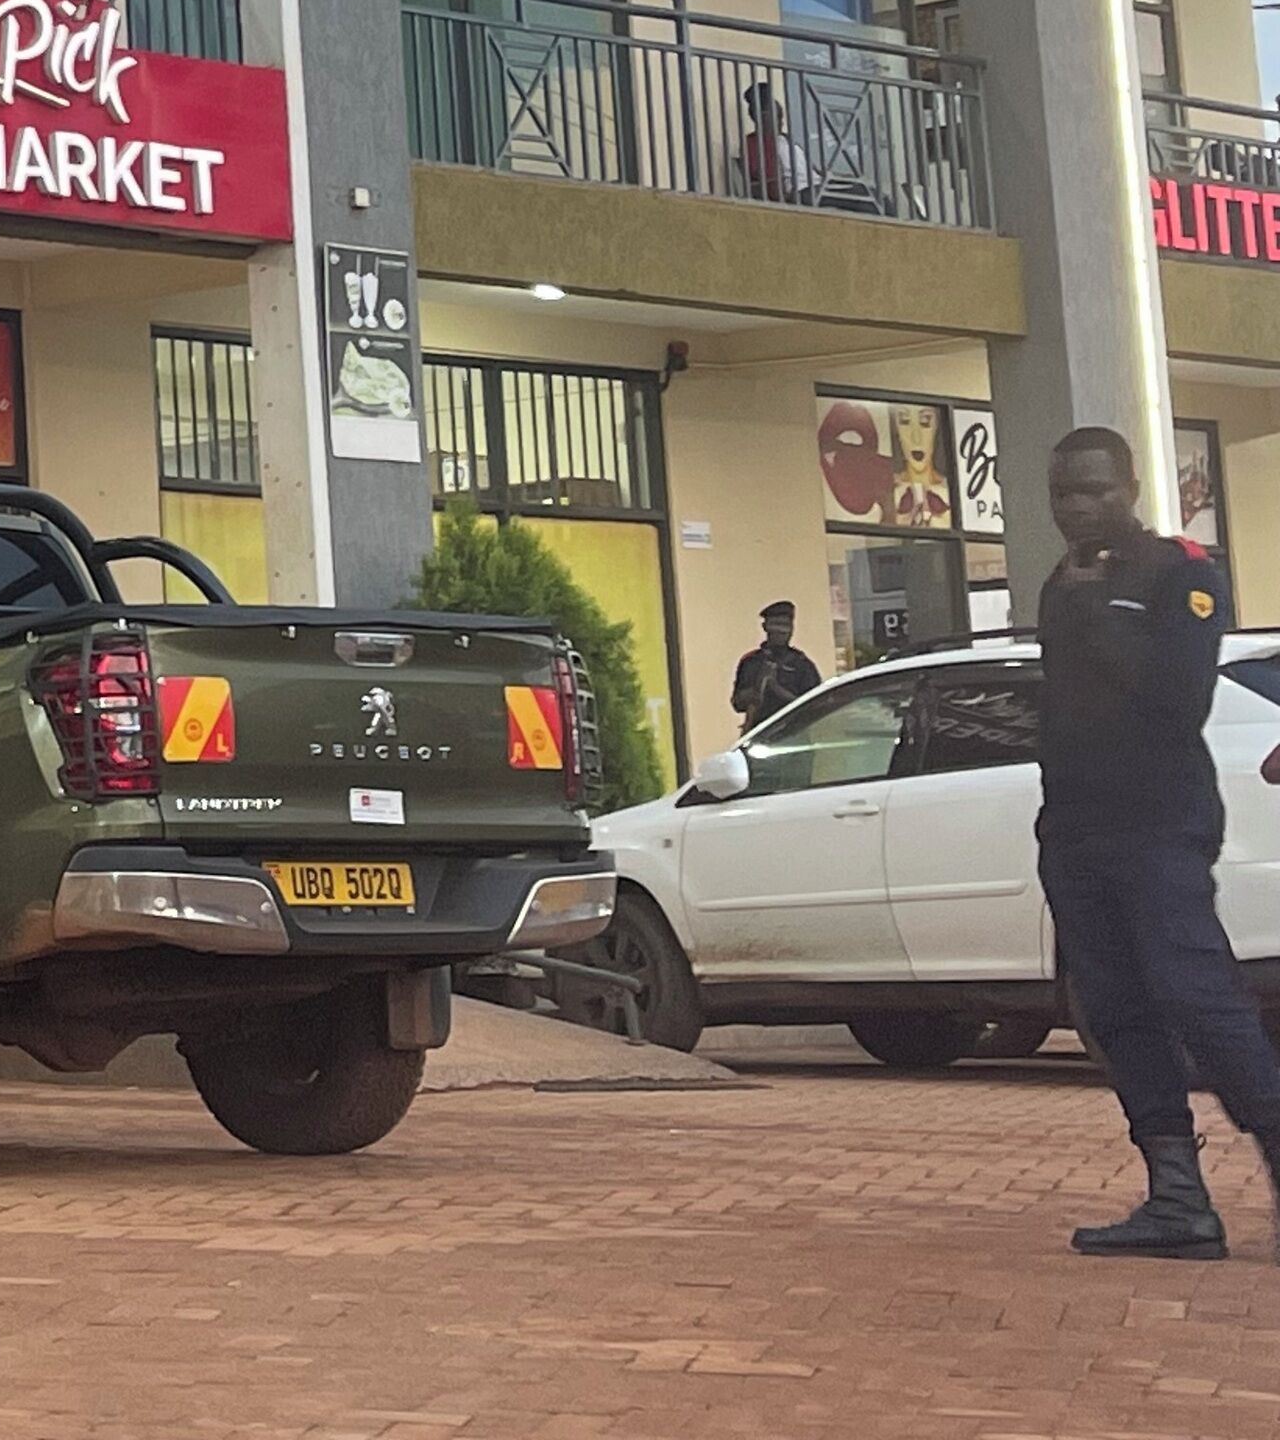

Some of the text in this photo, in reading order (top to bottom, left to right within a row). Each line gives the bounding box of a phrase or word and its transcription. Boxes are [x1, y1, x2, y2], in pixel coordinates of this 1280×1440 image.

[216, 733, 230, 753] L
[309, 743, 451, 760] PEUGEOT
[291, 867, 402, 900] UBQ 502Q
